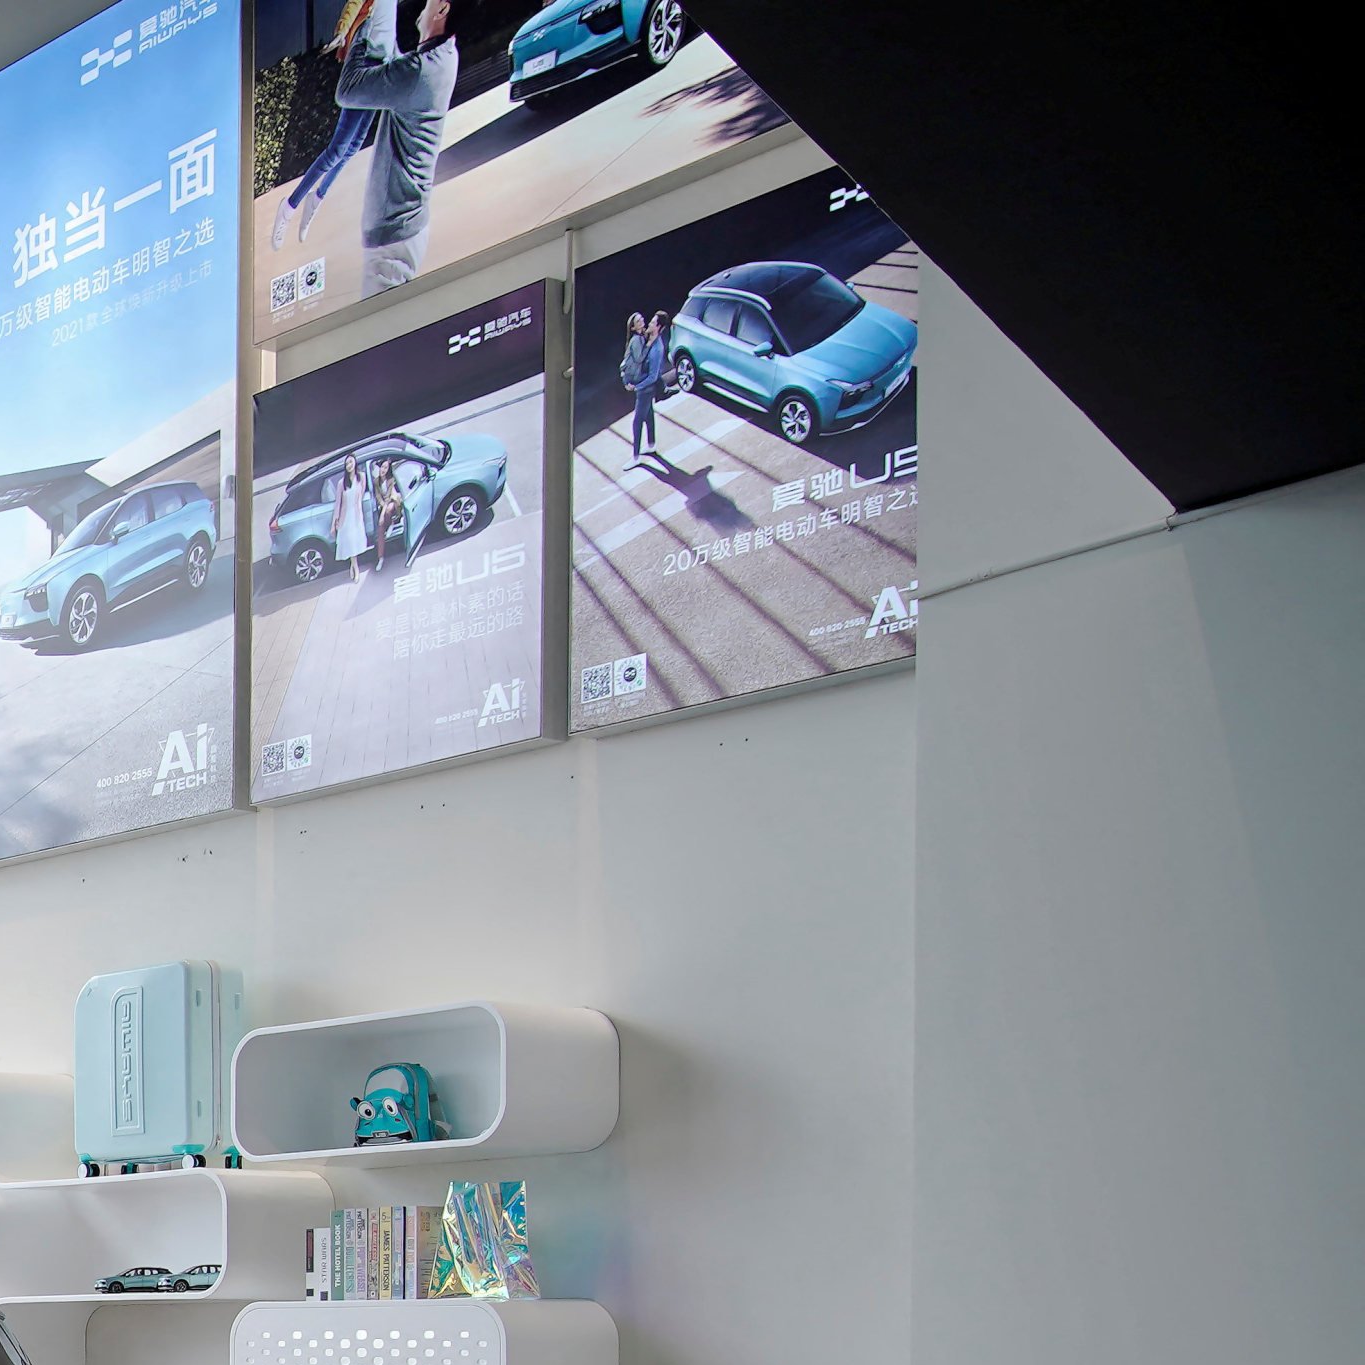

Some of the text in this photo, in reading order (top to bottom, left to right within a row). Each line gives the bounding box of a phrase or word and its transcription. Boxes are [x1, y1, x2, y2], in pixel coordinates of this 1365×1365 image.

[139, 2, 218, 54] AIWAYS
[12, 128, 218, 289] 独当一面
[376, 579, 525, 642] 爱是说最朴素的话
[393, 606, 525, 661] 陪你走最远的路
[880, 617, 919, 635] TECH
[481, 677, 521, 717] Ai
[489, 709, 521, 726] TECH
[96, 767, 153, 789] 400 820 2555
[155, 722, 208, 781] Ai
[166, 771, 208, 793] TECH
[120, 1000, 133, 1123] AIWAYS
[382, 1230, 390, 1291] JAMES PATTERSON
